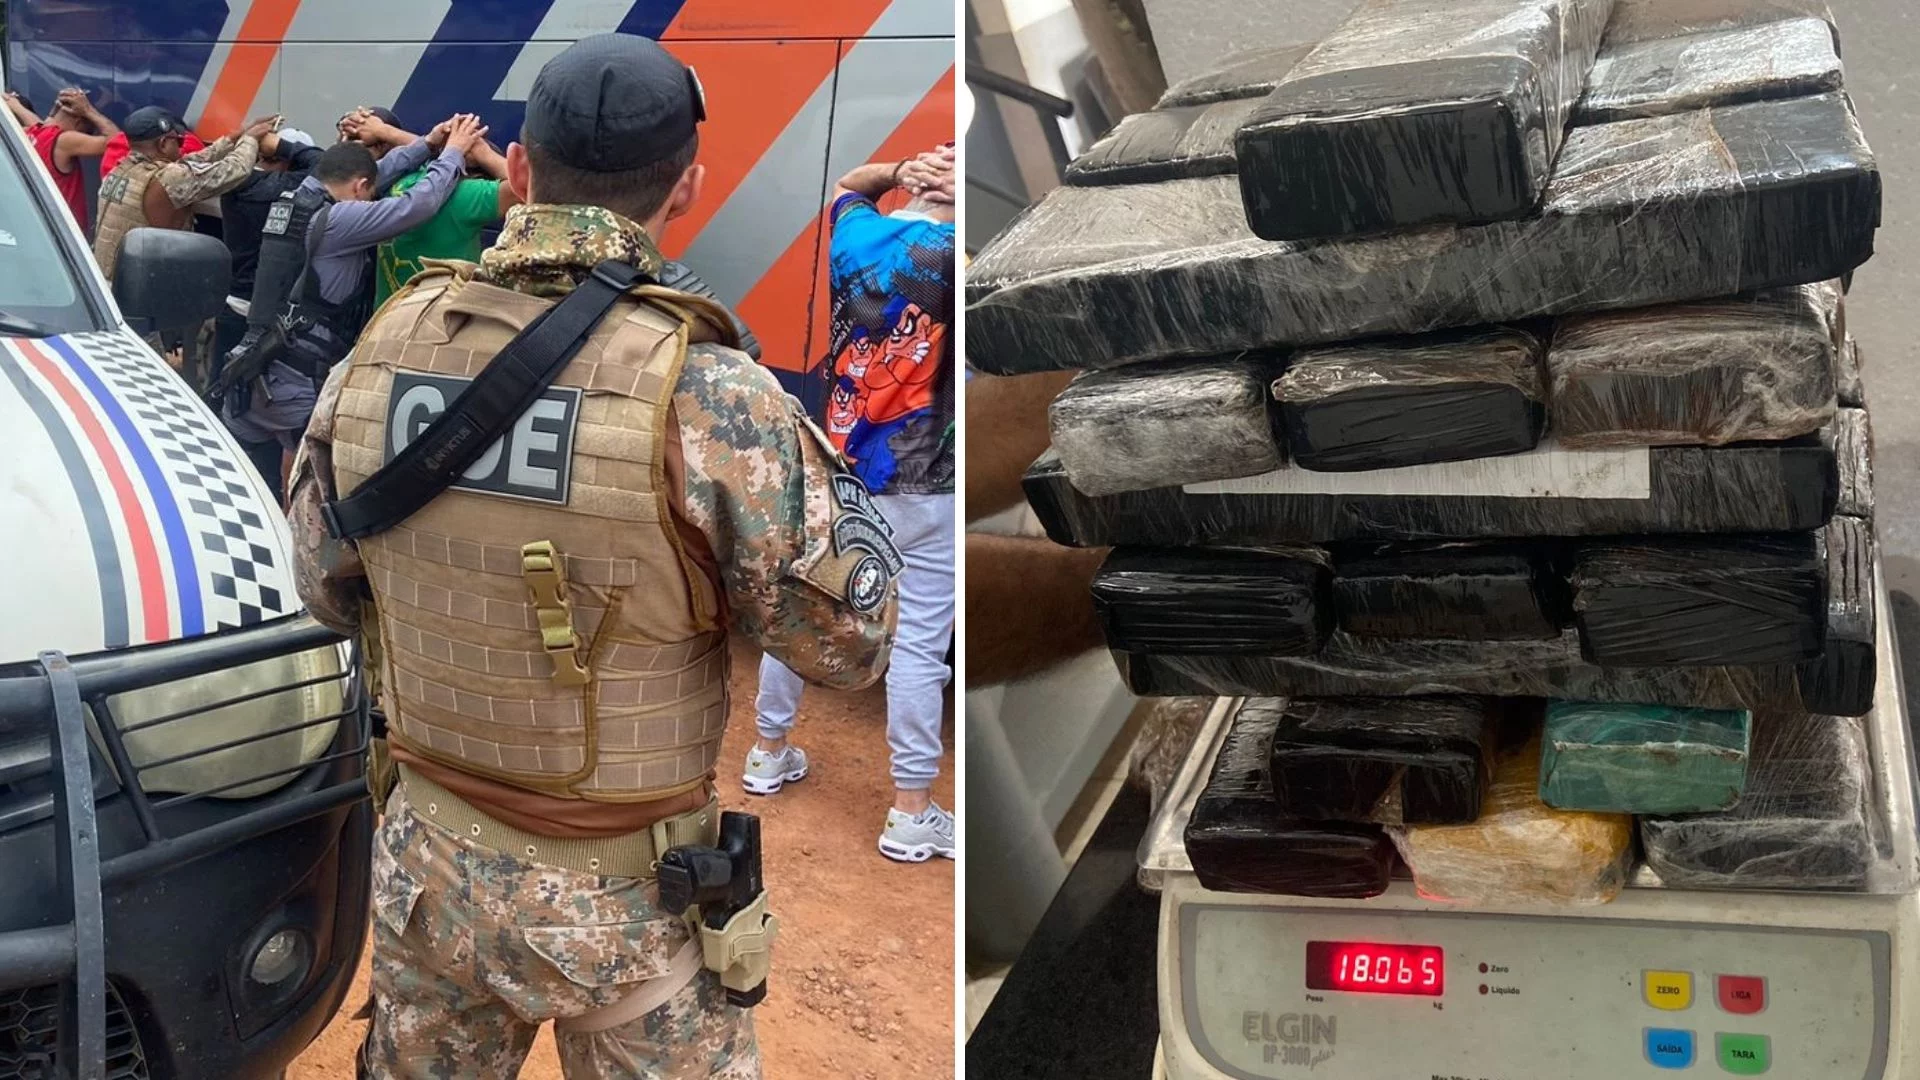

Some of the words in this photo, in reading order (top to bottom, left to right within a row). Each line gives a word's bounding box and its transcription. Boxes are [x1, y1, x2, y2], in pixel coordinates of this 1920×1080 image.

[1490, 964, 1509, 973] Zero
[1656, 985, 1680, 996] ZERO
[1730, 990, 1752, 1001] LIGA
[1305, 993, 1324, 1003] Peso
[1432, 1001, 1444, 1011] kg
[1242, 1010, 1337, 1045] ELGIN
[1731, 1049, 1756, 1060] TARA
